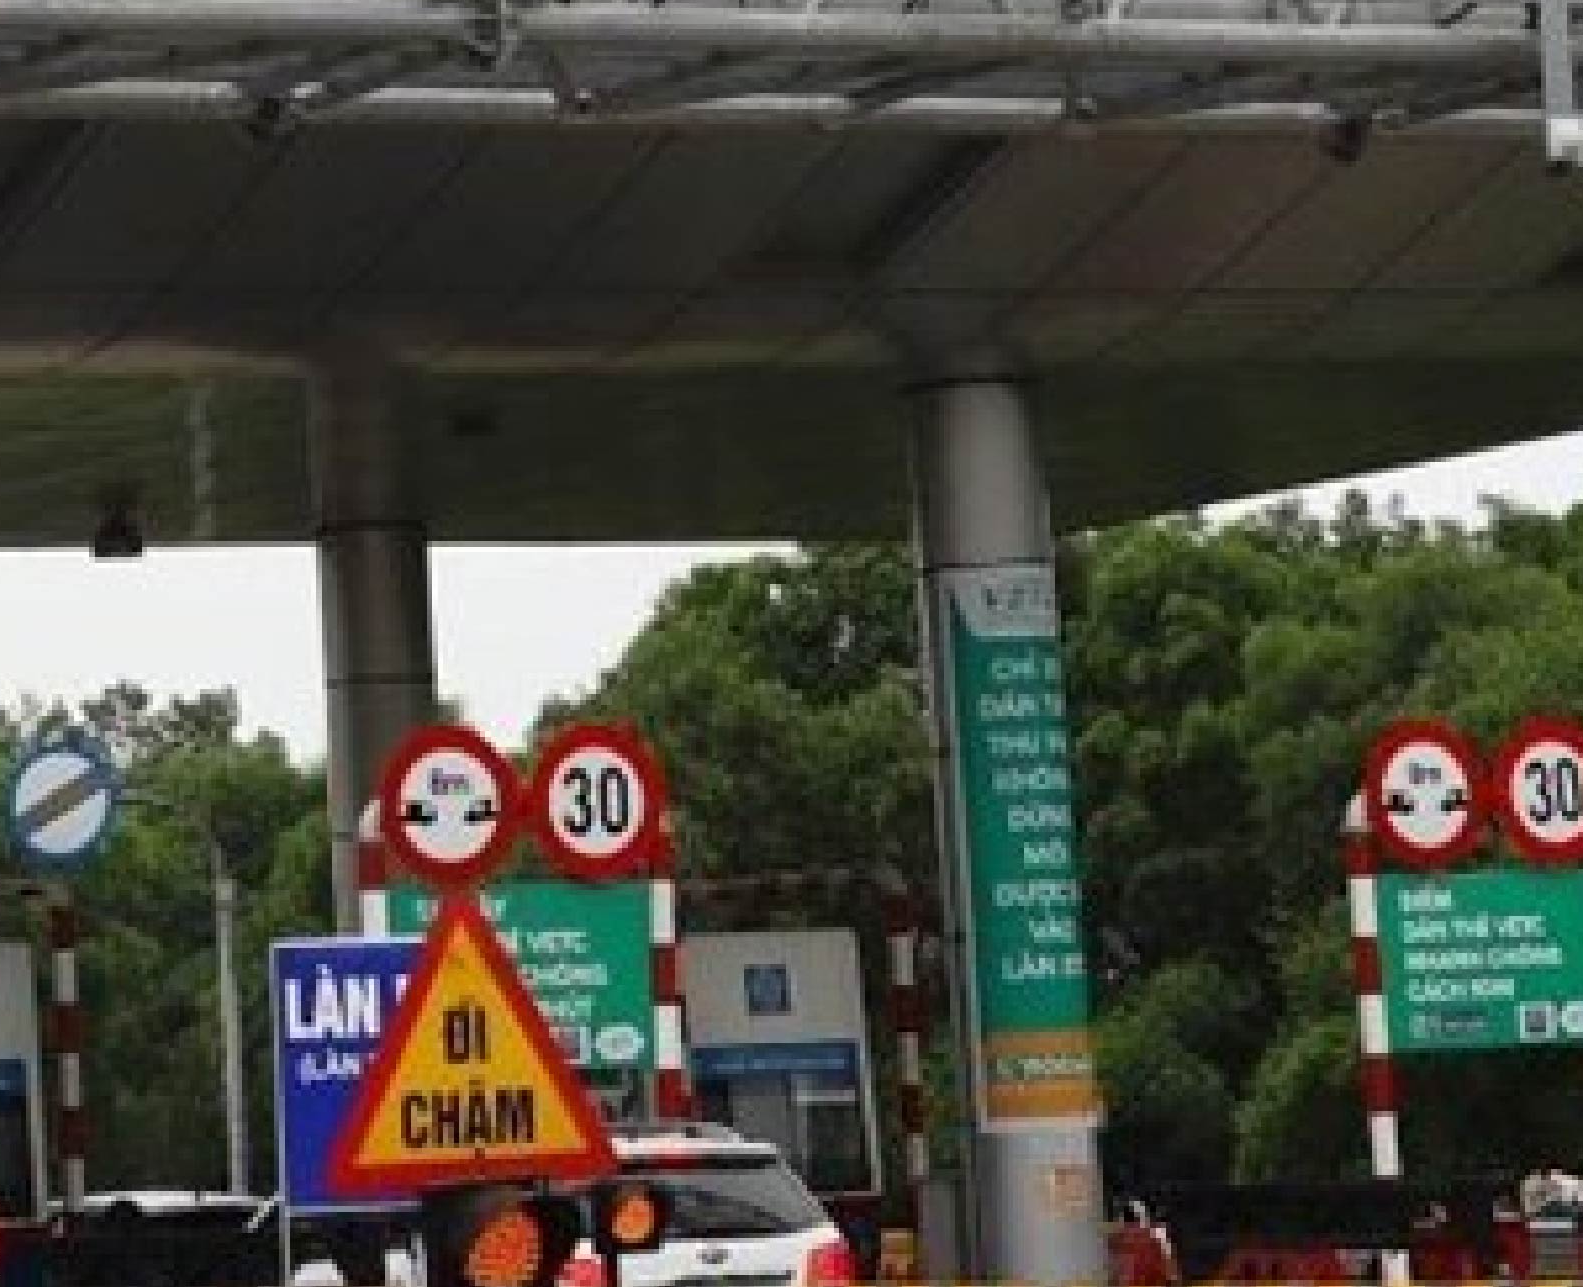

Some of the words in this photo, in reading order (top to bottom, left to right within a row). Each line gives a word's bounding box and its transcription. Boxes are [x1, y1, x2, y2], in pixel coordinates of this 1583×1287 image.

[563, 765, 631, 836] 30
[1524, 757, 1581, 823] 30
[284, 962, 381, 1040] LÀN
